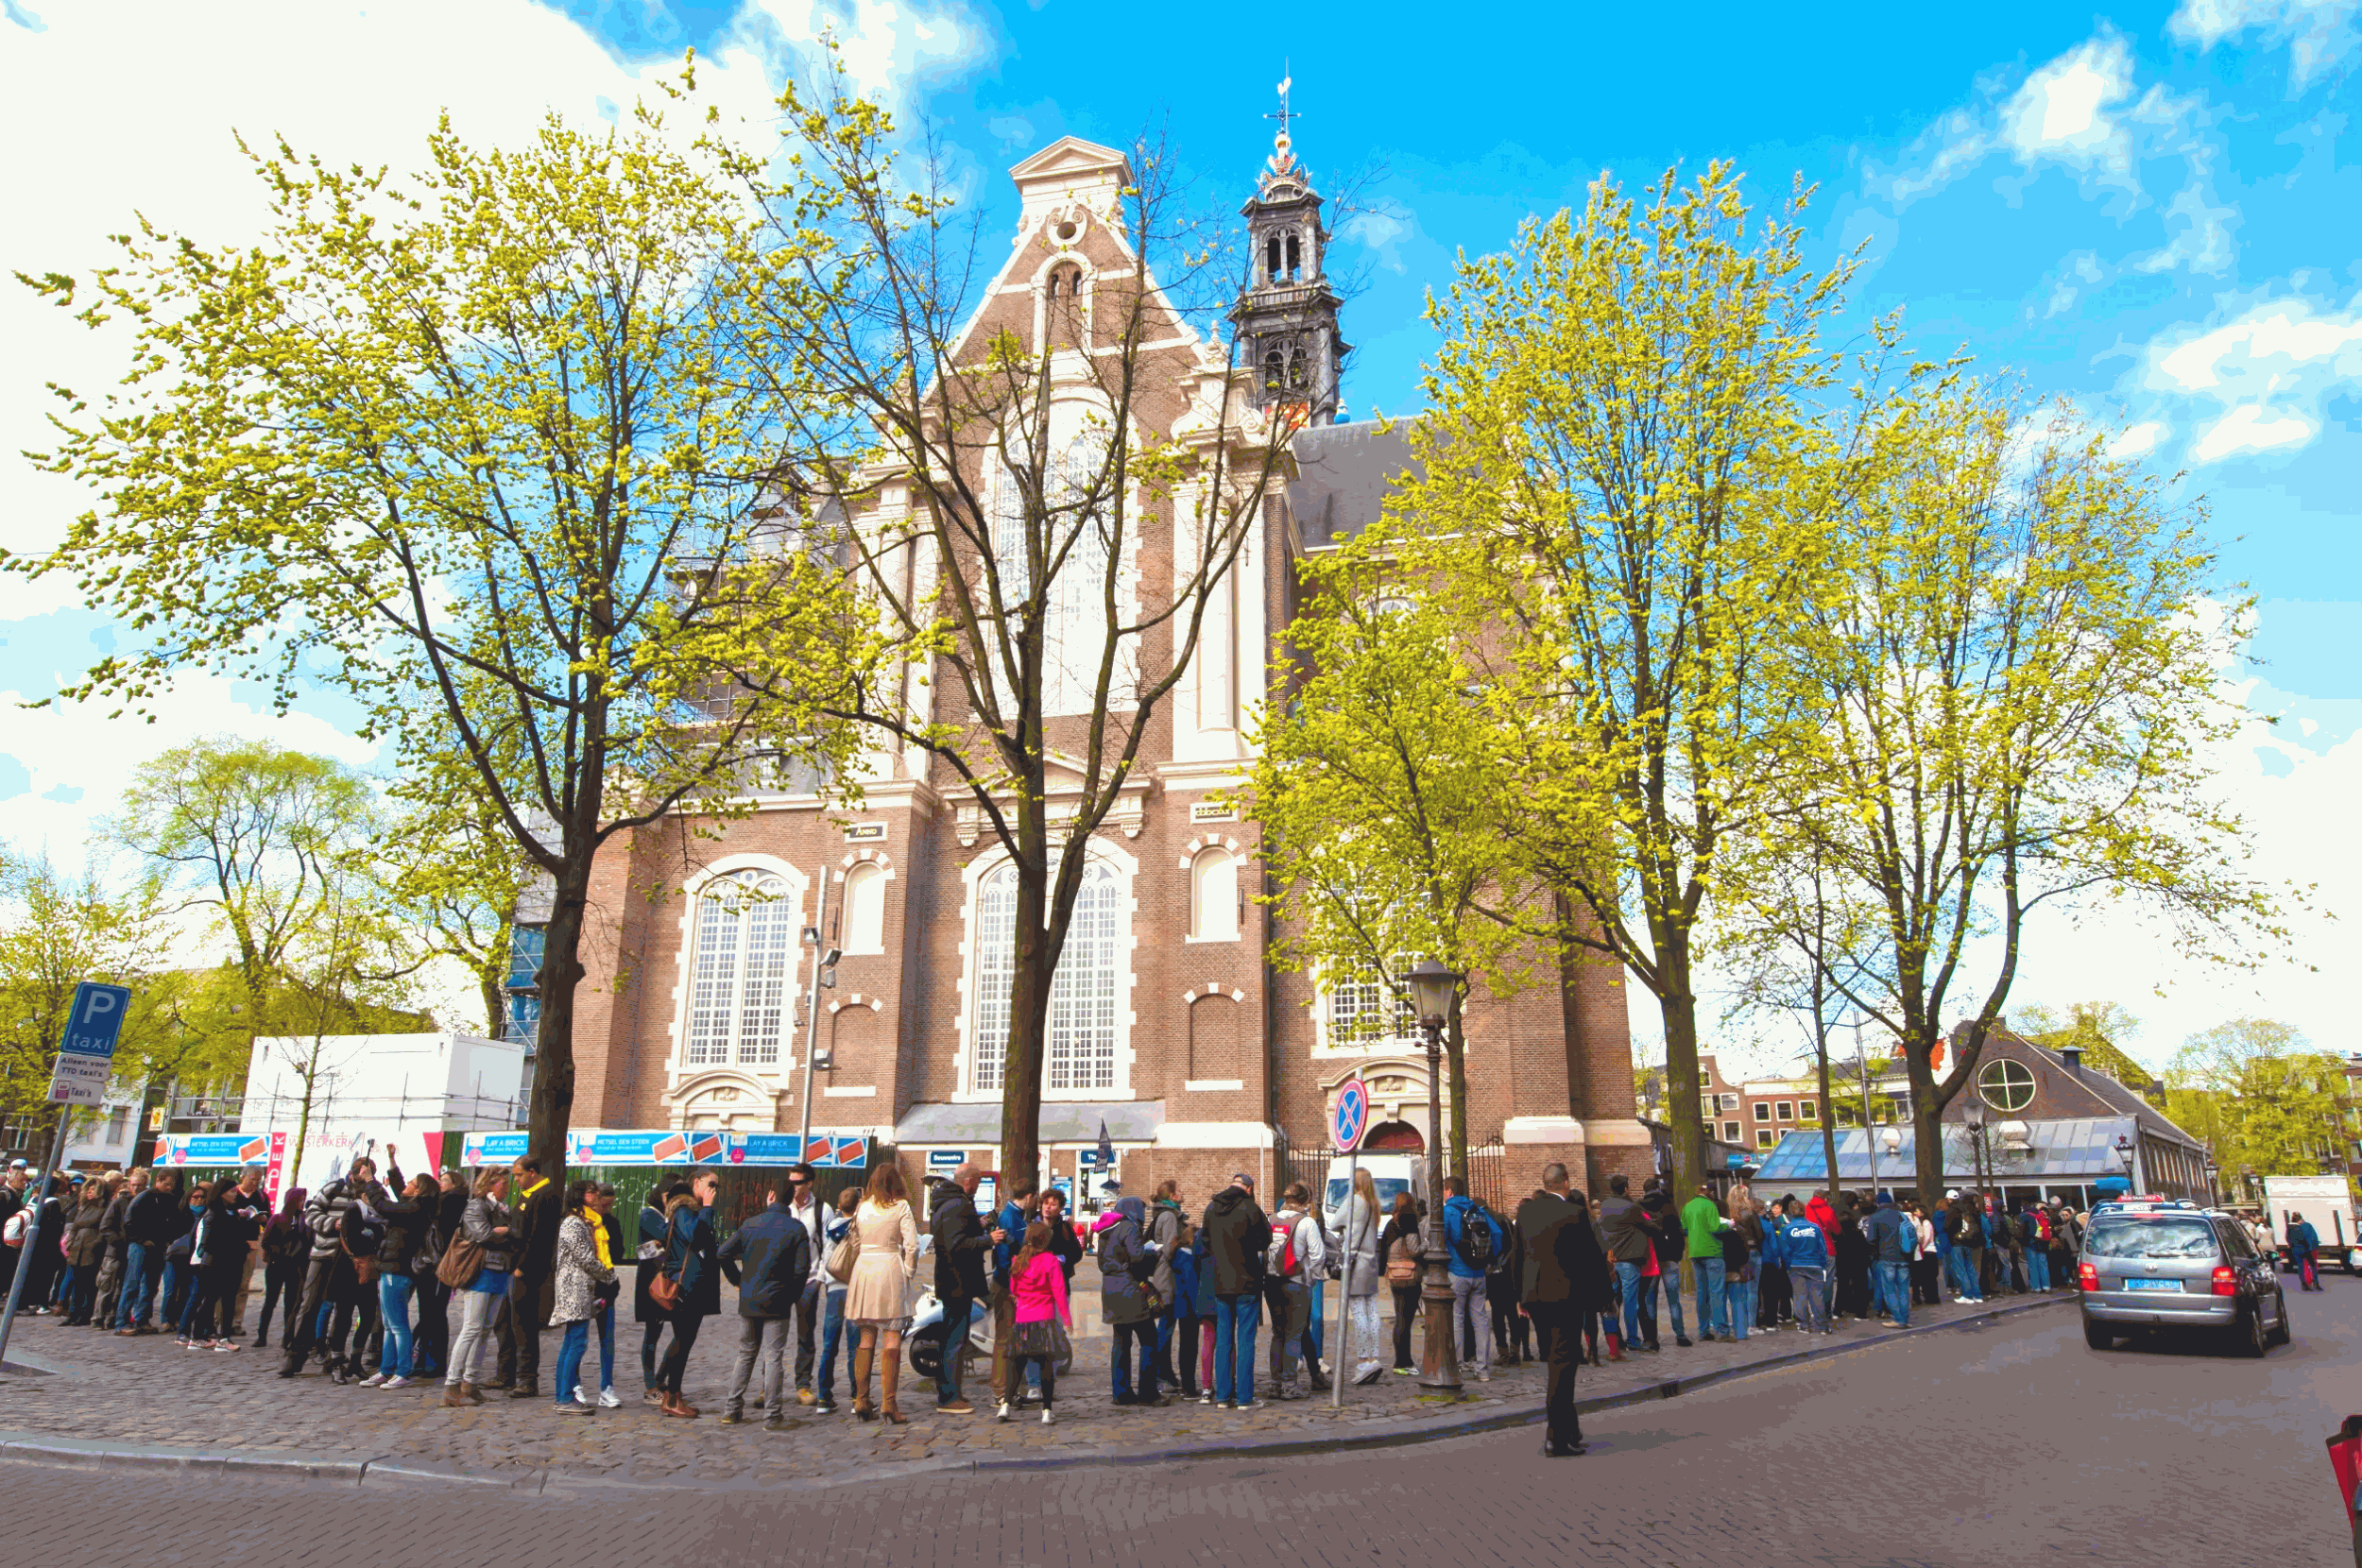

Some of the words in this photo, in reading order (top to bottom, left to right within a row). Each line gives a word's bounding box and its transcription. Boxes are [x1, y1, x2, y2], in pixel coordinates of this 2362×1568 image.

[83, 991, 115, 1023] P
[72, 1033, 111, 1049] taxi
[61, 1066, 77, 1075] TTO
[71, 1087, 92, 1098] Taxi's
[288, 1135, 354, 1150] WSTERKERK
[486, 1139, 499, 1148] LAY
[505, 1138, 525, 1147] BRICK
